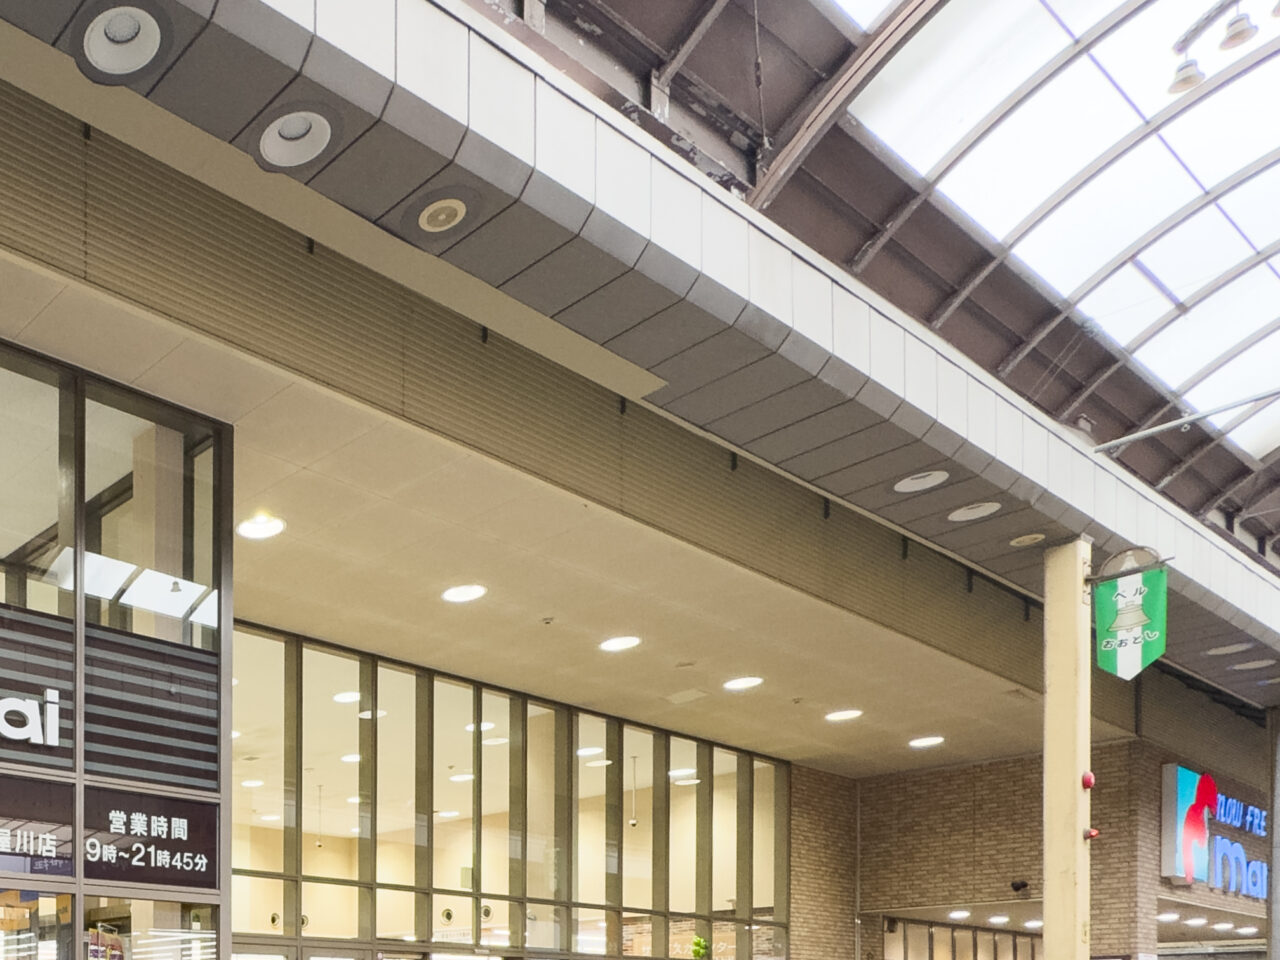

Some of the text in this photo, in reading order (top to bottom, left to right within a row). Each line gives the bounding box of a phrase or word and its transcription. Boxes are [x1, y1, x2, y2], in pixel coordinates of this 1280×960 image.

[109, 810, 188, 841] 営業時間
[1246, 805, 1267, 836] FRE
